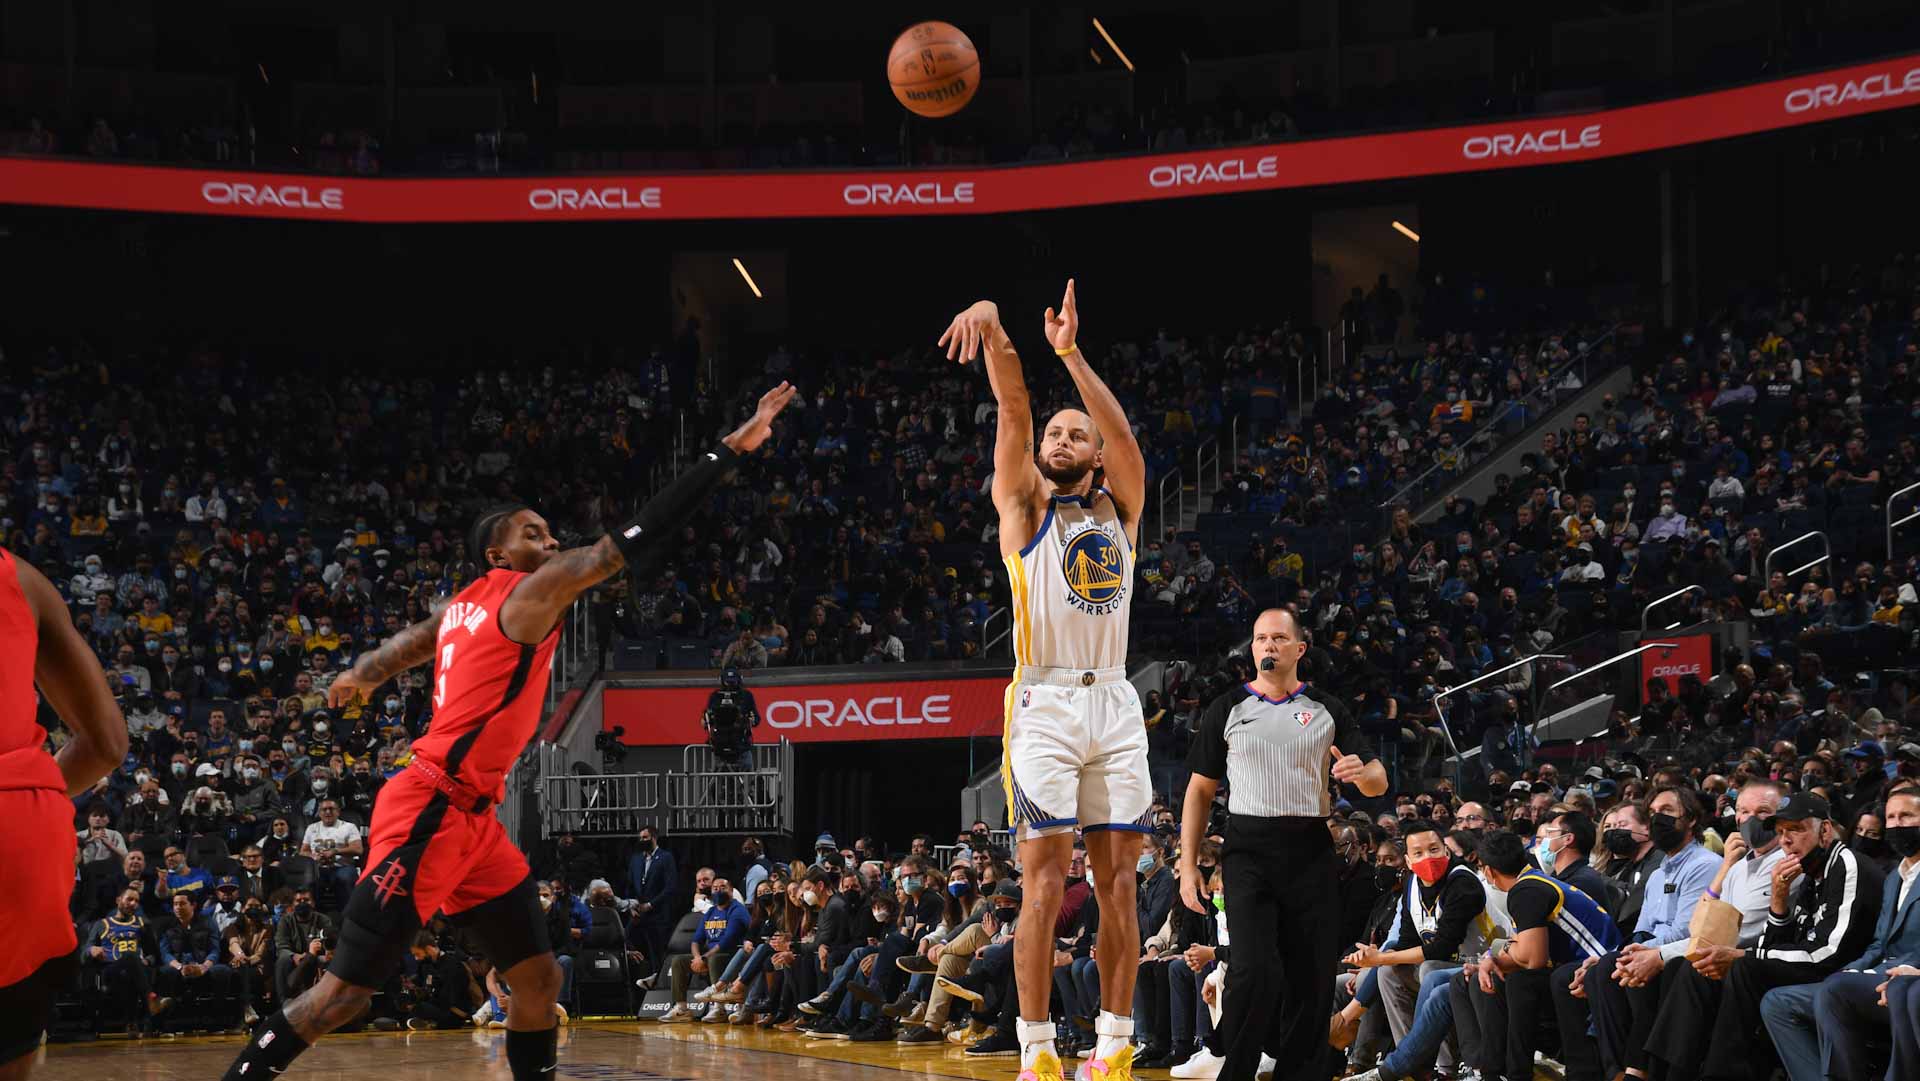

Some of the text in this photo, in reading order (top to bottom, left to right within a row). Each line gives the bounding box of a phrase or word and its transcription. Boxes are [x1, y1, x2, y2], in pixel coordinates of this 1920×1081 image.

[1784, 68, 1920, 113] ORACLE
[1462, 124, 1602, 160] ORACLE
[1149, 156, 1278, 188] ORACLE
[202, 181, 343, 210] ORACLE
[529, 187, 661, 211] ORACLE
[843, 182, 975, 205] ORACLE
[1099, 546, 1117, 567] 30
[1066, 584, 1127, 616] WARRIORS
[1652, 663, 1701, 677] ORACLE
[766, 695, 952, 729] ORACLE
[118, 940, 138, 953] 23
[643, 1003, 665, 1011] CHASE
